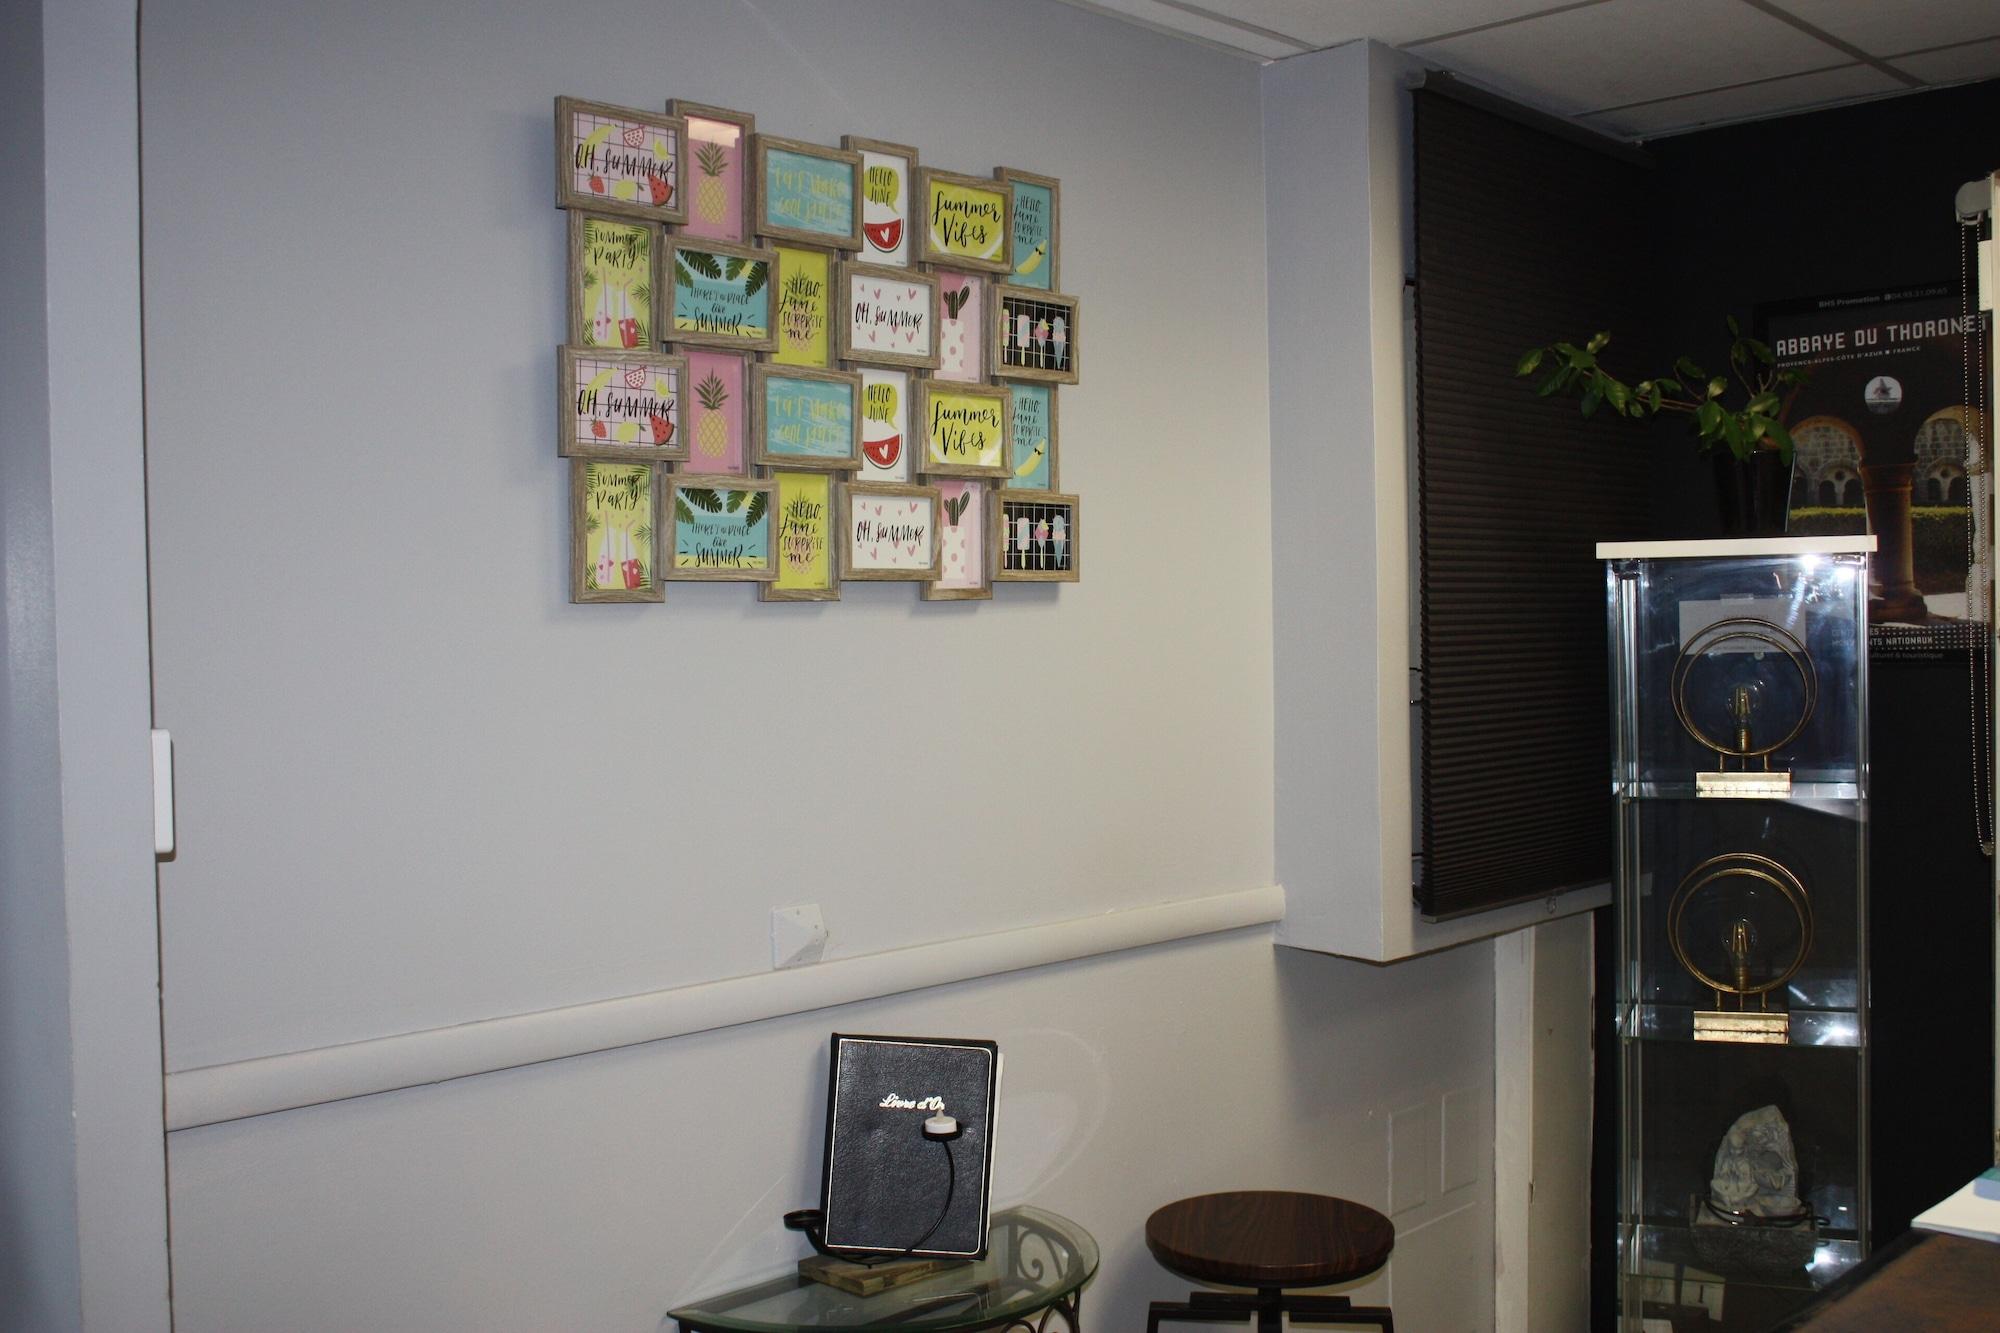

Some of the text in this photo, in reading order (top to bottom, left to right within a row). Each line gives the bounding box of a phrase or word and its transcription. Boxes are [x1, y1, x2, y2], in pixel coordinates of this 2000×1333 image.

[869, 165, 892, 186] HELLO
[870, 186, 891, 207] JUNE
[943, 213, 988, 248] Vibes
[1776, 332, 1846, 357] ABBAYE
[1855, 328, 1878, 347] DU
[868, 383, 891, 404] HELLO
[868, 403, 889, 424] JUNE
[942, 421, 987, 456] Vibes
